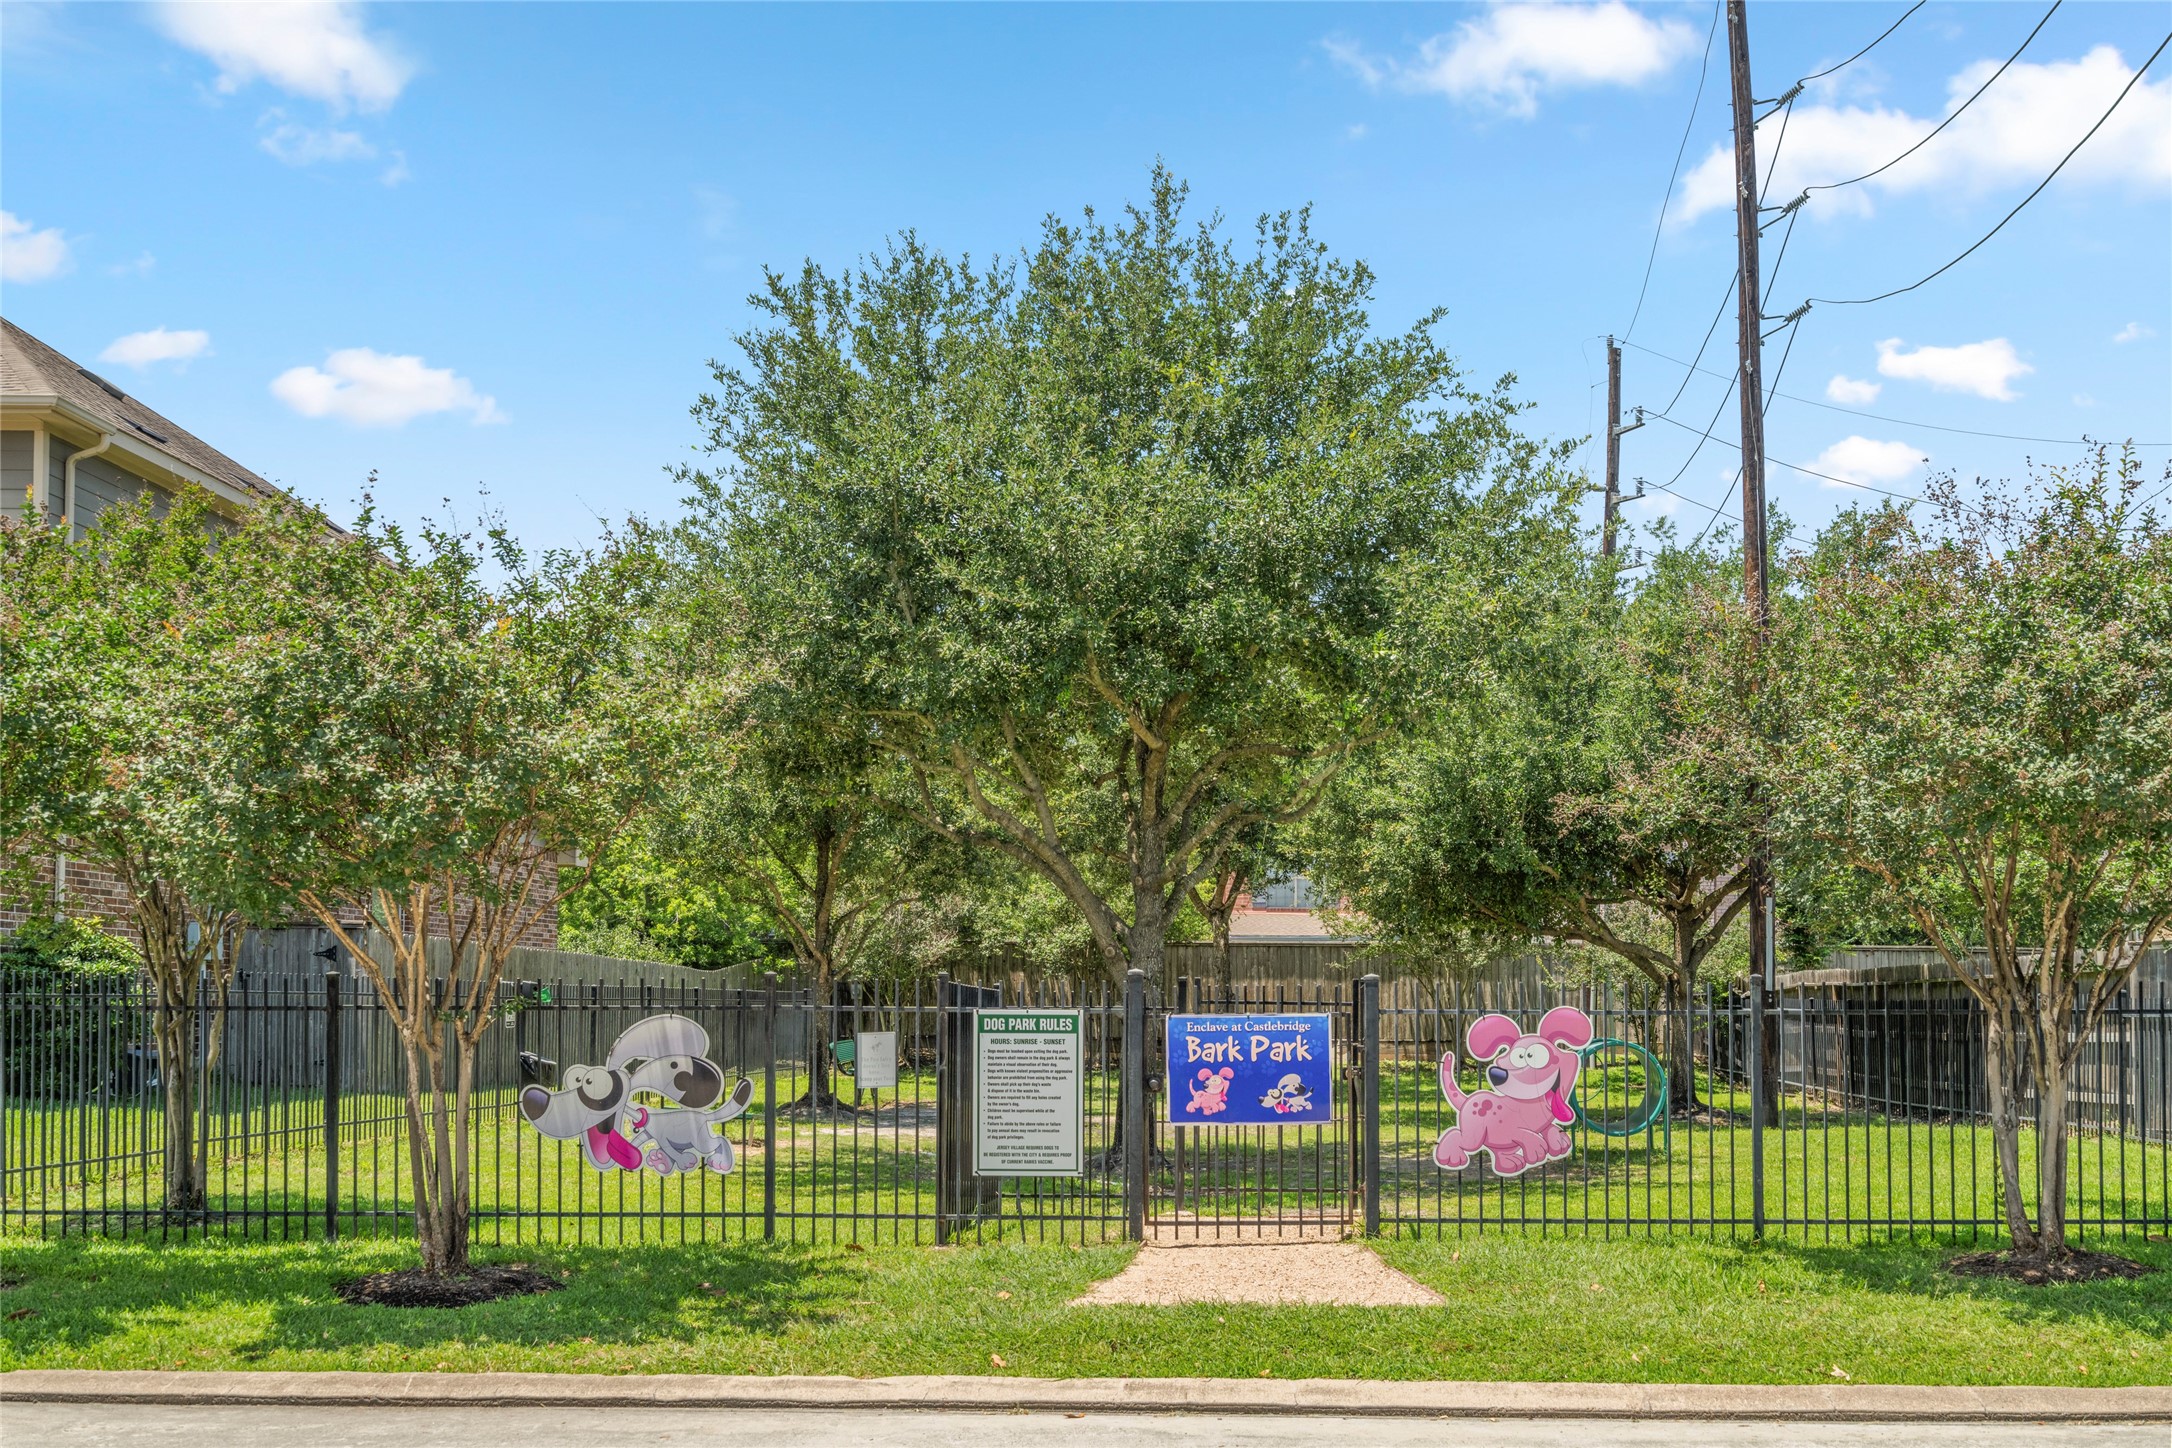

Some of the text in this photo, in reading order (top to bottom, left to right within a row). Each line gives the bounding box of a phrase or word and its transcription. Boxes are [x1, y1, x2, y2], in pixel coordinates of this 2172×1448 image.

[984, 1018, 1072, 1031] DOG PARK RULES
[1186, 1021, 1311, 1033] Enclave at Castlebridge
[1186, 1035, 1312, 1063] Bark Park
